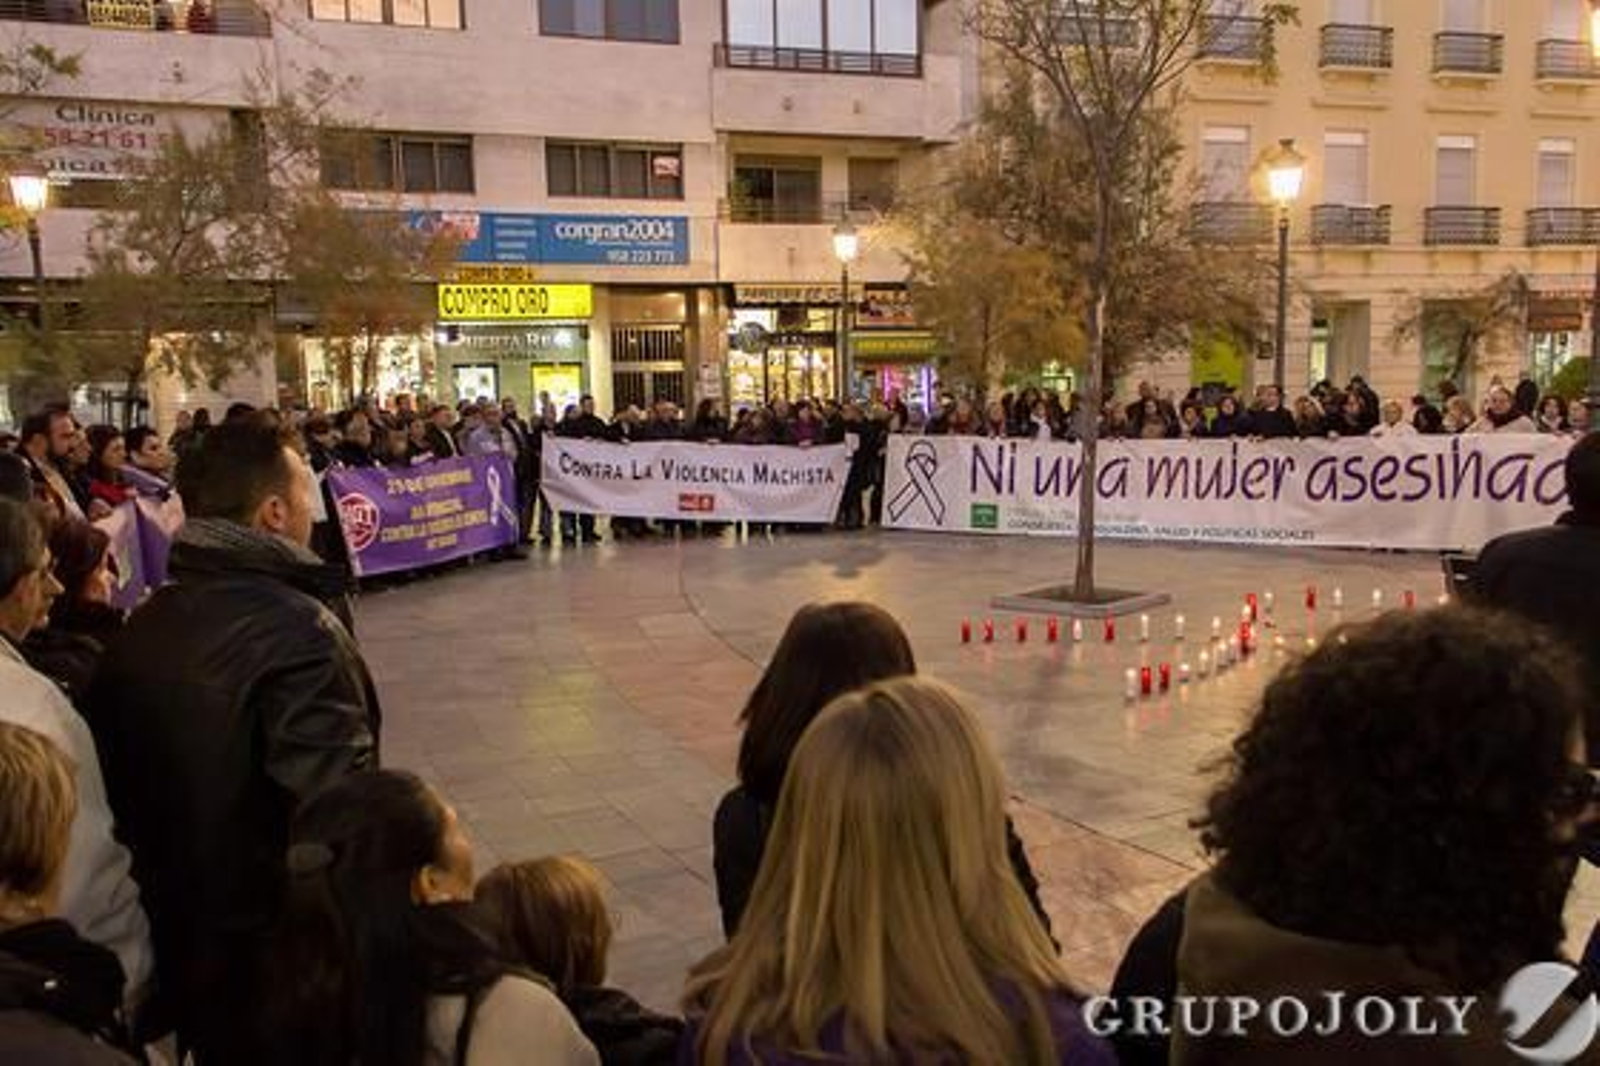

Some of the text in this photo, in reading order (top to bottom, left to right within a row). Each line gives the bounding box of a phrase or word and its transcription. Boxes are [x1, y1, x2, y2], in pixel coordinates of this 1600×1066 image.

[442, 287, 548, 314] COMPRO ORO
[970, 442, 1018, 497] Ni
[1146, 441, 1294, 500] mujer
